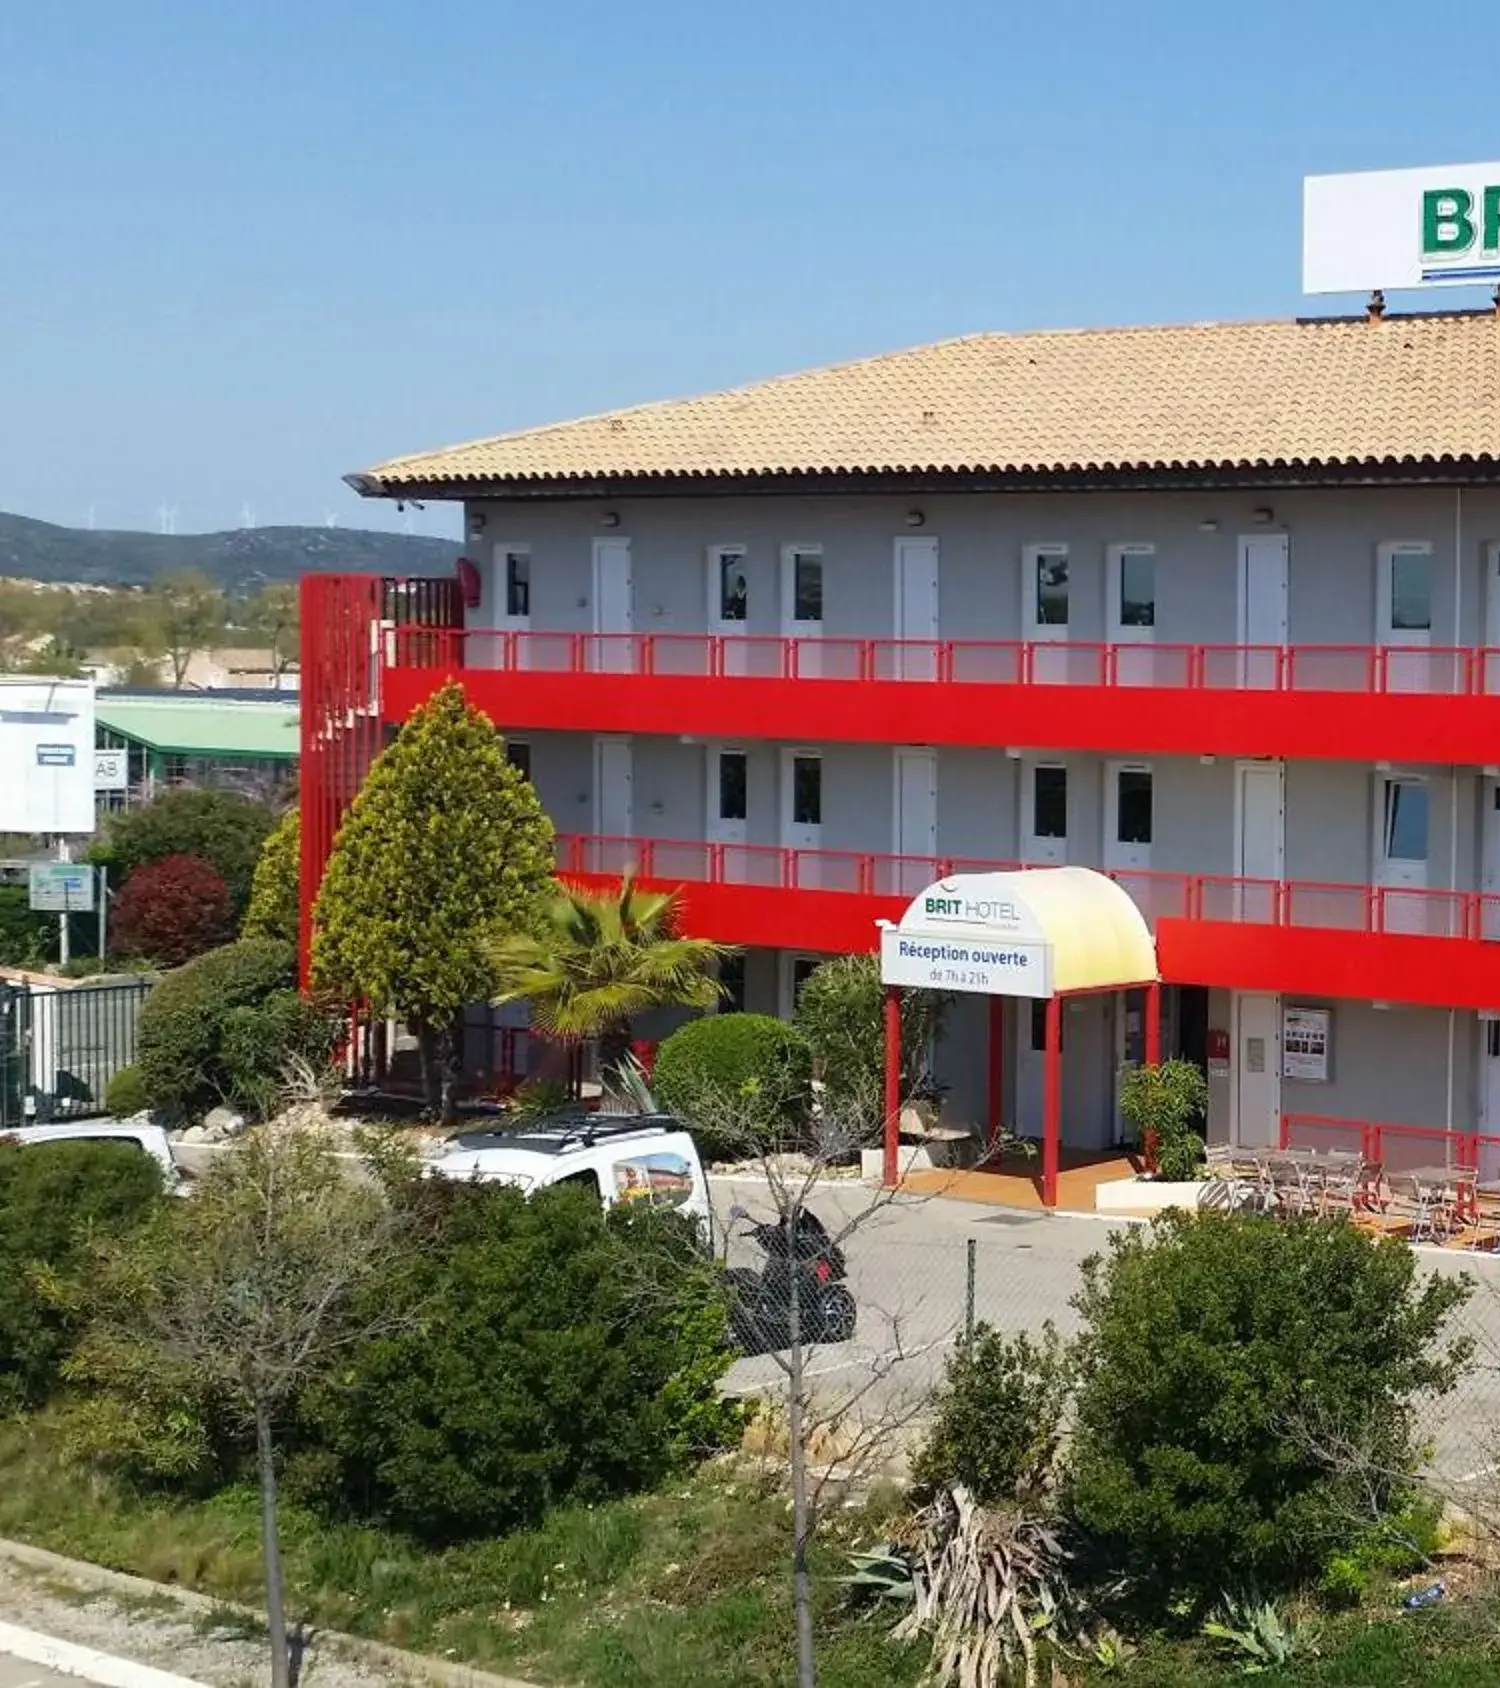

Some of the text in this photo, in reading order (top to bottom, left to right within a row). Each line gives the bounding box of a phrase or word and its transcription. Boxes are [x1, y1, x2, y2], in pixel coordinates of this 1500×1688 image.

[925, 898, 1021, 920] BRIT HOTEL
[899, 941, 1028, 967] Réception ouverte
[930, 968, 942, 981] de
[945, 970, 959, 982] 7h
